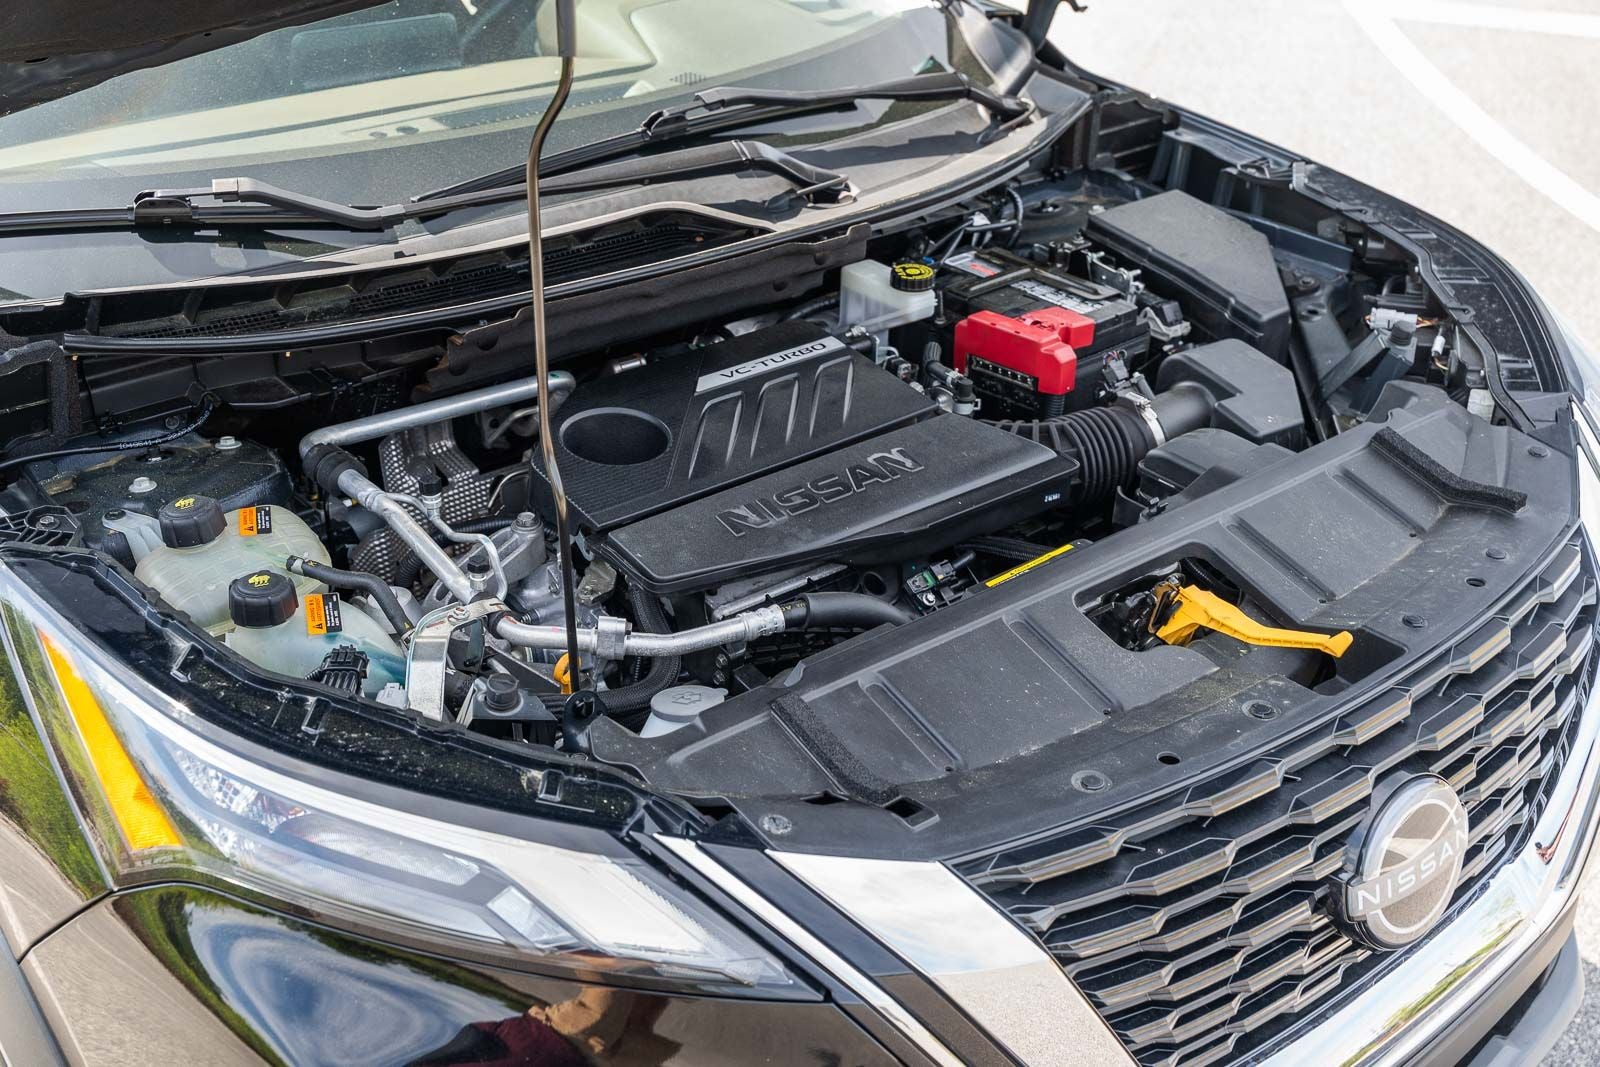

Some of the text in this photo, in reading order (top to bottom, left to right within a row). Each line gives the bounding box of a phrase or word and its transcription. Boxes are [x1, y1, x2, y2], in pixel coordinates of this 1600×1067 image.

[720, 343, 827, 379] VC-TURBO
[715, 448, 925, 537] NISSAN
[1357, 829, 1468, 911] NISSAN
